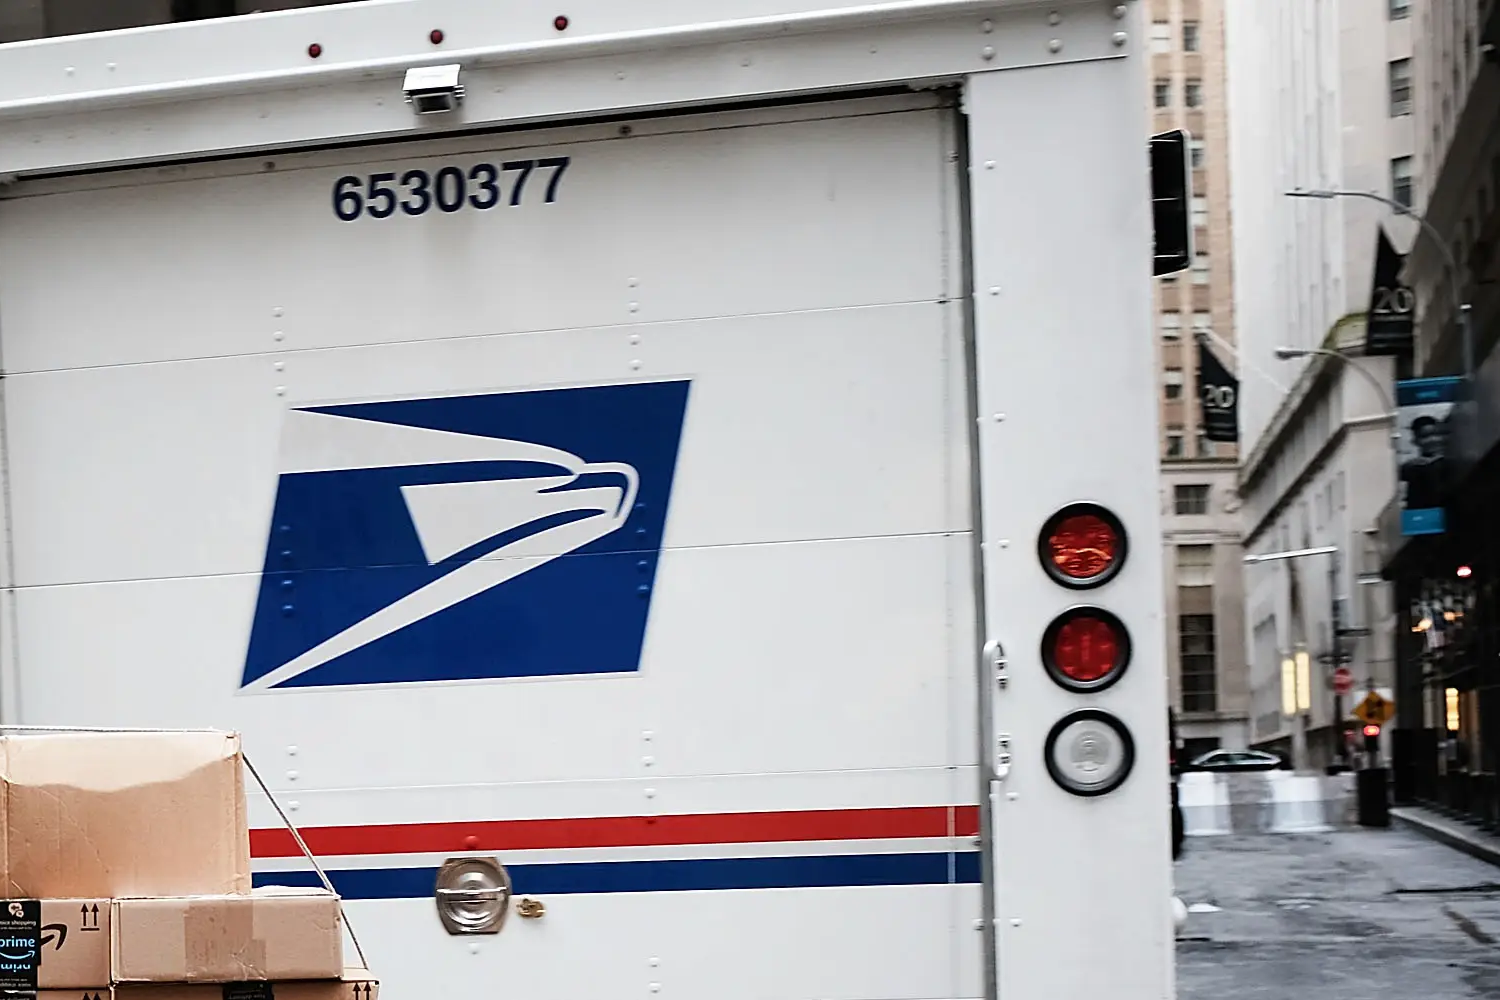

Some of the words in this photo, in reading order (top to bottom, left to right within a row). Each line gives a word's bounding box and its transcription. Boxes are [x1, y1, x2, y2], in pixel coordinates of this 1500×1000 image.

[333, 157, 571, 221] 6530377
[1373, 287, 1415, 313] 20
[1202, 384, 1235, 408] 20
